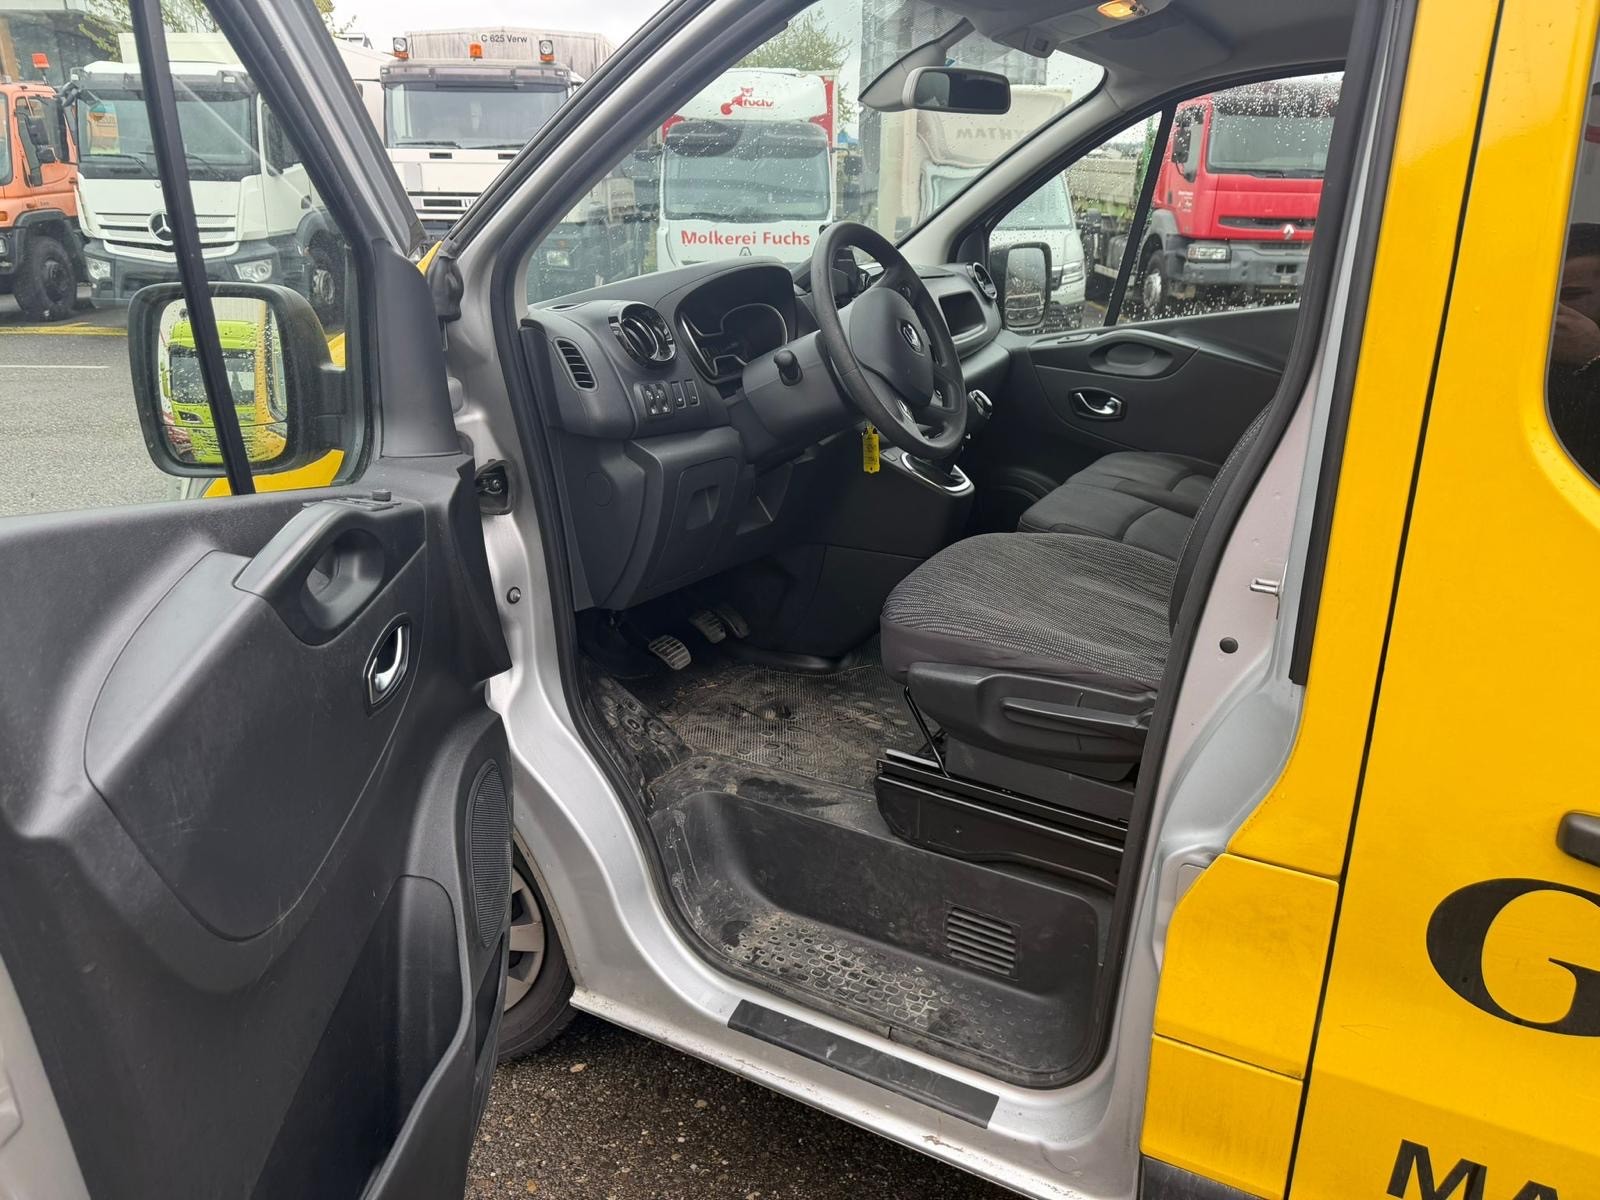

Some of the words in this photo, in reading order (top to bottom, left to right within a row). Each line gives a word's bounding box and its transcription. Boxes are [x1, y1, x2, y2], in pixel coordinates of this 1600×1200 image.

[481, 34, 488, 43] C
[490, 34, 505, 43] 625
[506, 35, 528, 43] Verw
[681, 230, 757, 245] Molkerei
[763, 231, 810, 245] Fuchs
